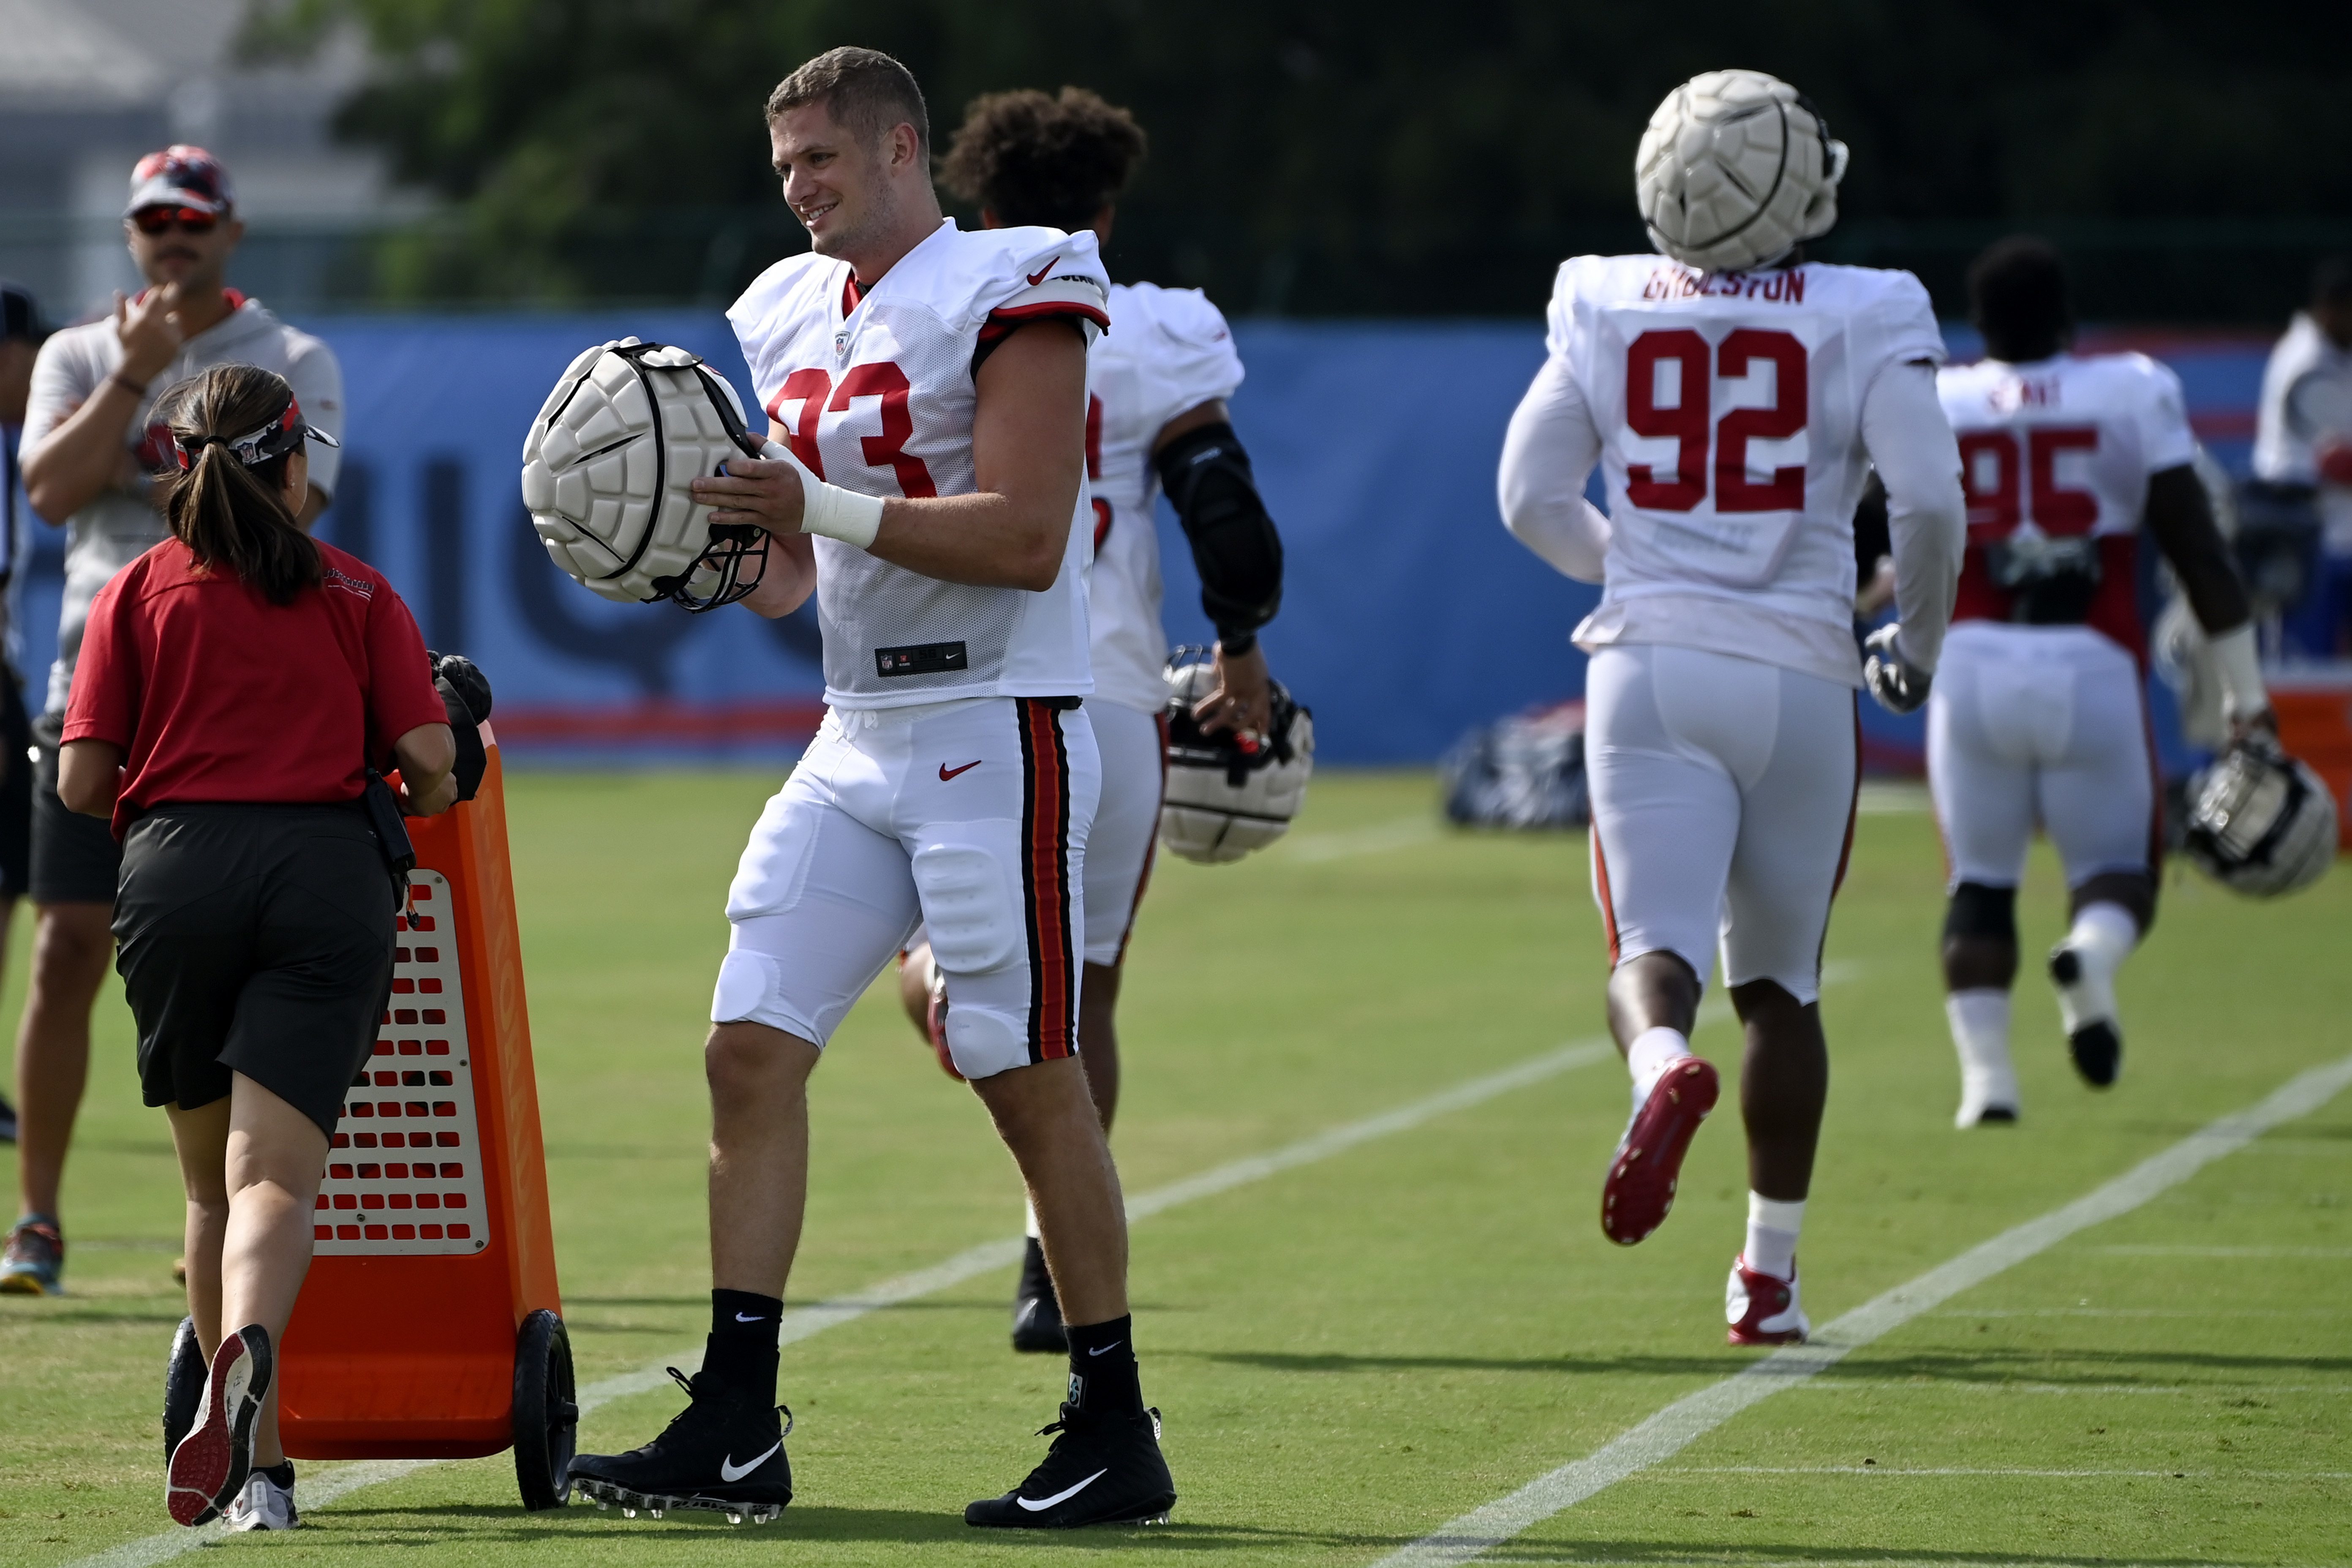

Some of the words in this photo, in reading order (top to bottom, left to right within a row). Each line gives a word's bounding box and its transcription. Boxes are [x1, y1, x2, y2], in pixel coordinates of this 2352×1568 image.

[766, 361, 938, 499] 93
[1625, 328, 1808, 513] 92
[1958, 426, 2100, 538] 95
